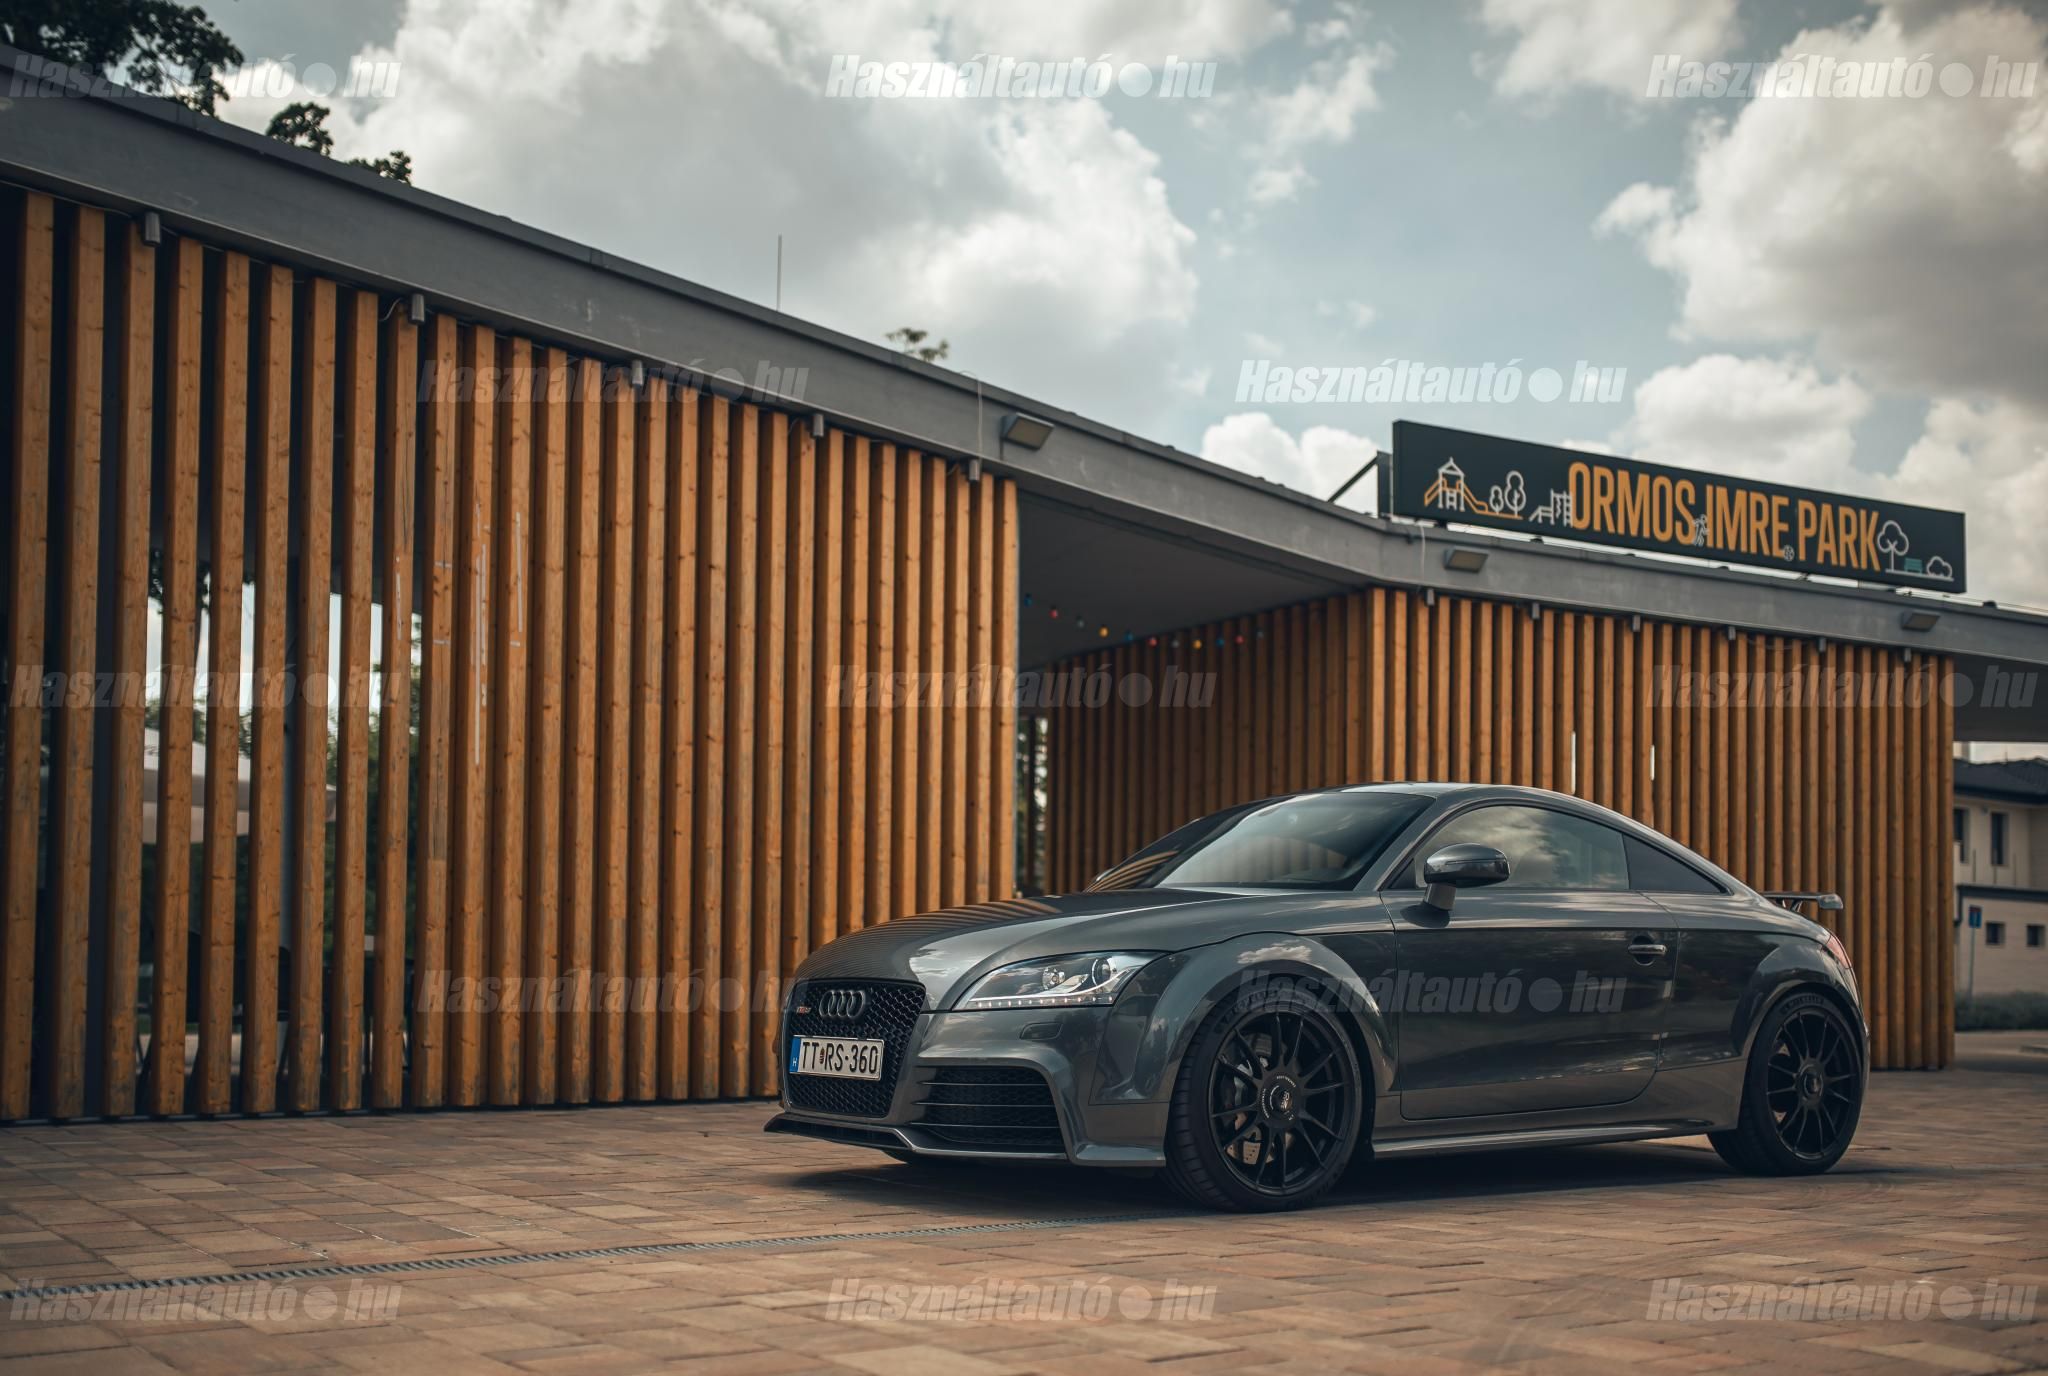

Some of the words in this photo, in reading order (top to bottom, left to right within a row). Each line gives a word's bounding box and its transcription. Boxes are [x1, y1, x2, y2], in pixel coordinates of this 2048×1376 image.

[1568, 461, 1696, 545] ORMOS
[1706, 484, 1790, 558] IMRE
[1798, 499, 1881, 572] PARK
[802, 1041, 819, 1070] TT
